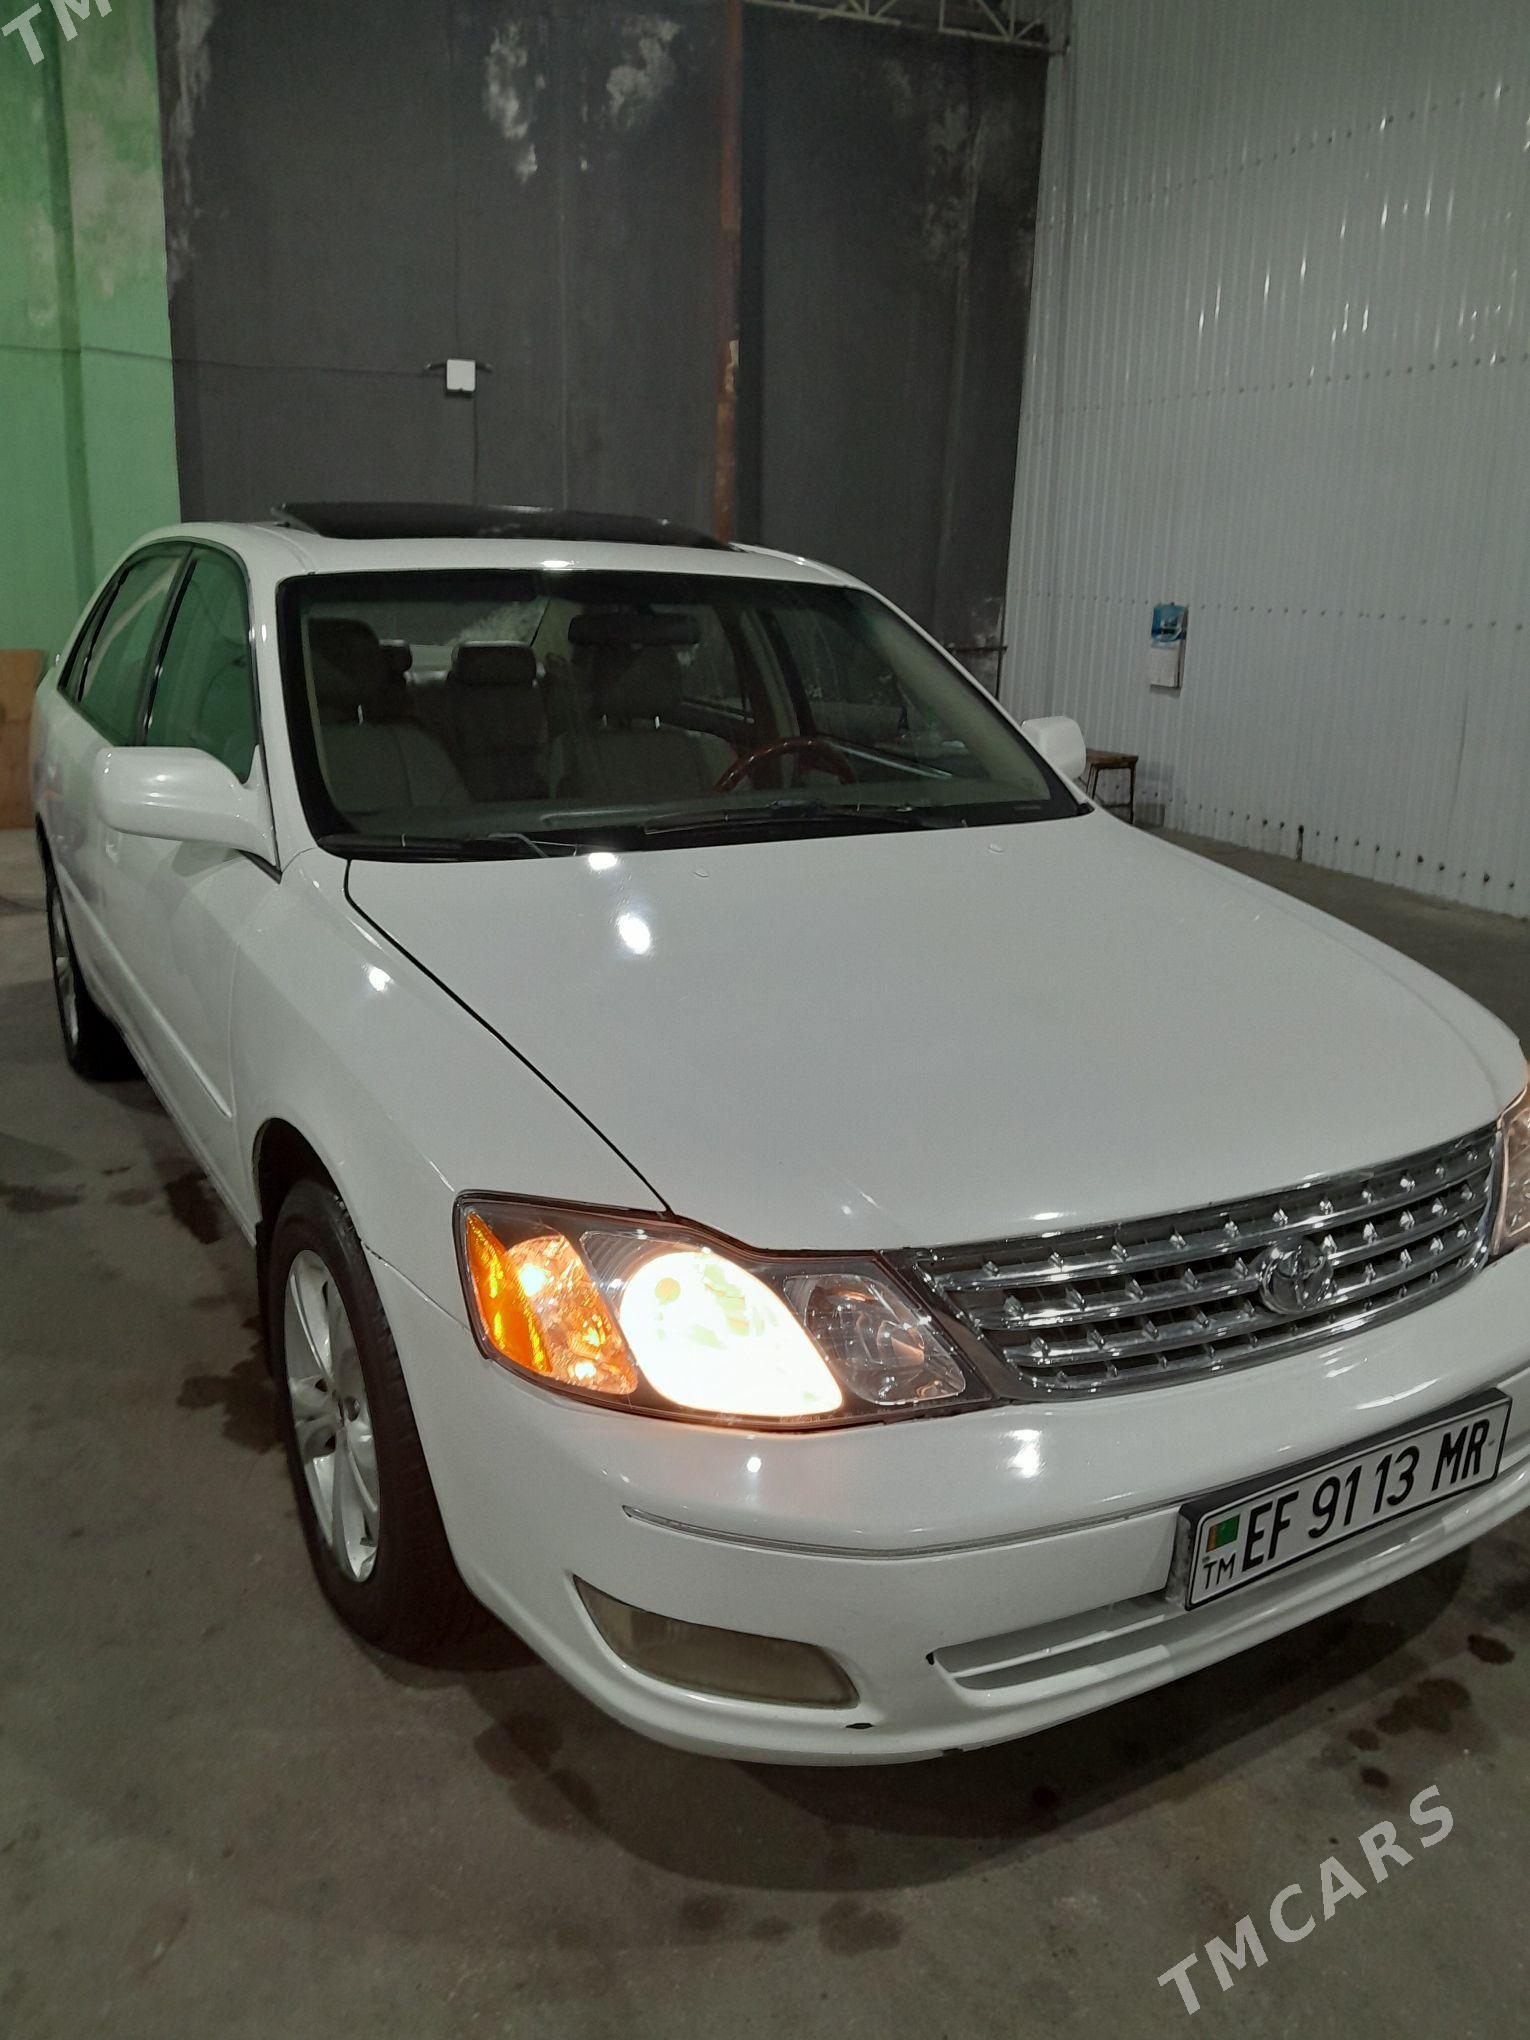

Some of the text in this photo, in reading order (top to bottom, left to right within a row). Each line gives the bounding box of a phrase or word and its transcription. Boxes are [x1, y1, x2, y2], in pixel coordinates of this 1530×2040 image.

[1242, 1490, 1299, 1572] EF
[1431, 1418, 1490, 1491] MR
[1203, 1553, 1236, 1589] TM
